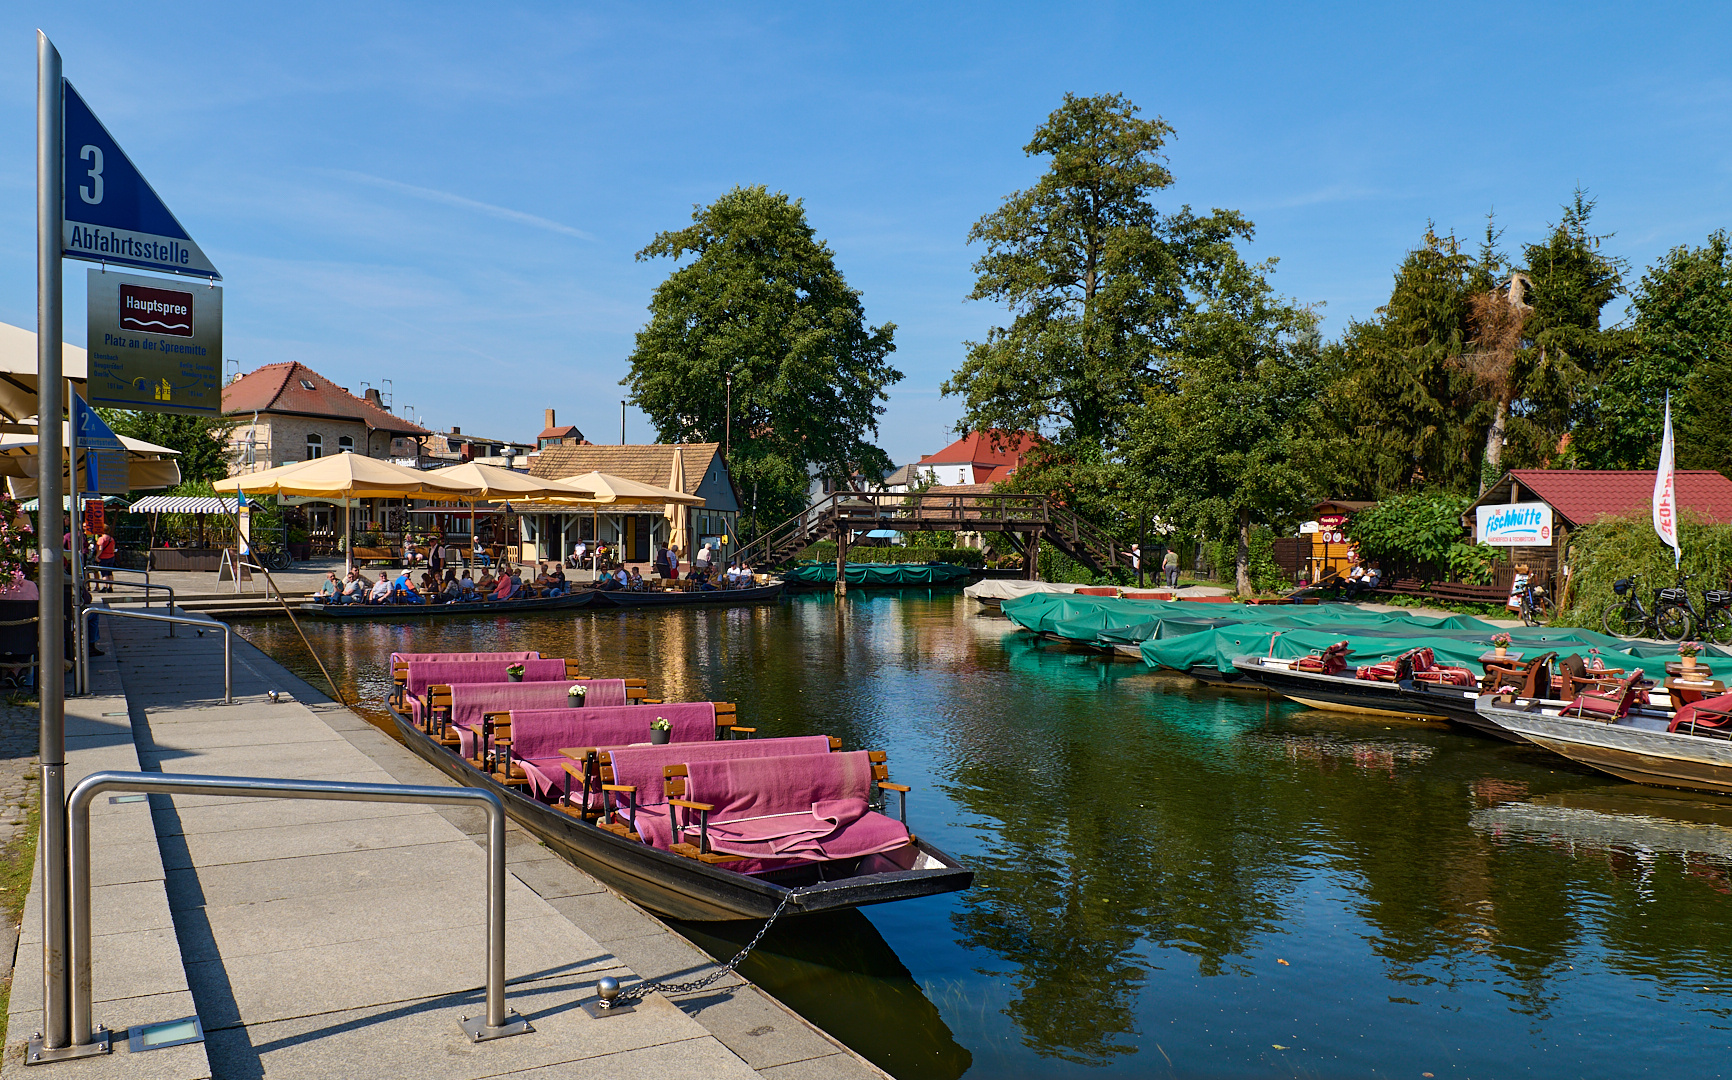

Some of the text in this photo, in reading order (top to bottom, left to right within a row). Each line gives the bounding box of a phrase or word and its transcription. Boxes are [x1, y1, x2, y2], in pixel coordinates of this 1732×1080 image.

[80, 144, 104, 205] 3
[71, 225, 189, 264] Abfahrtsstelle
[126, 295, 187, 316] Hauptspree
[104, 333, 207, 357] Platz an der Spreemitte
[81, 412, 90, 431] 2
